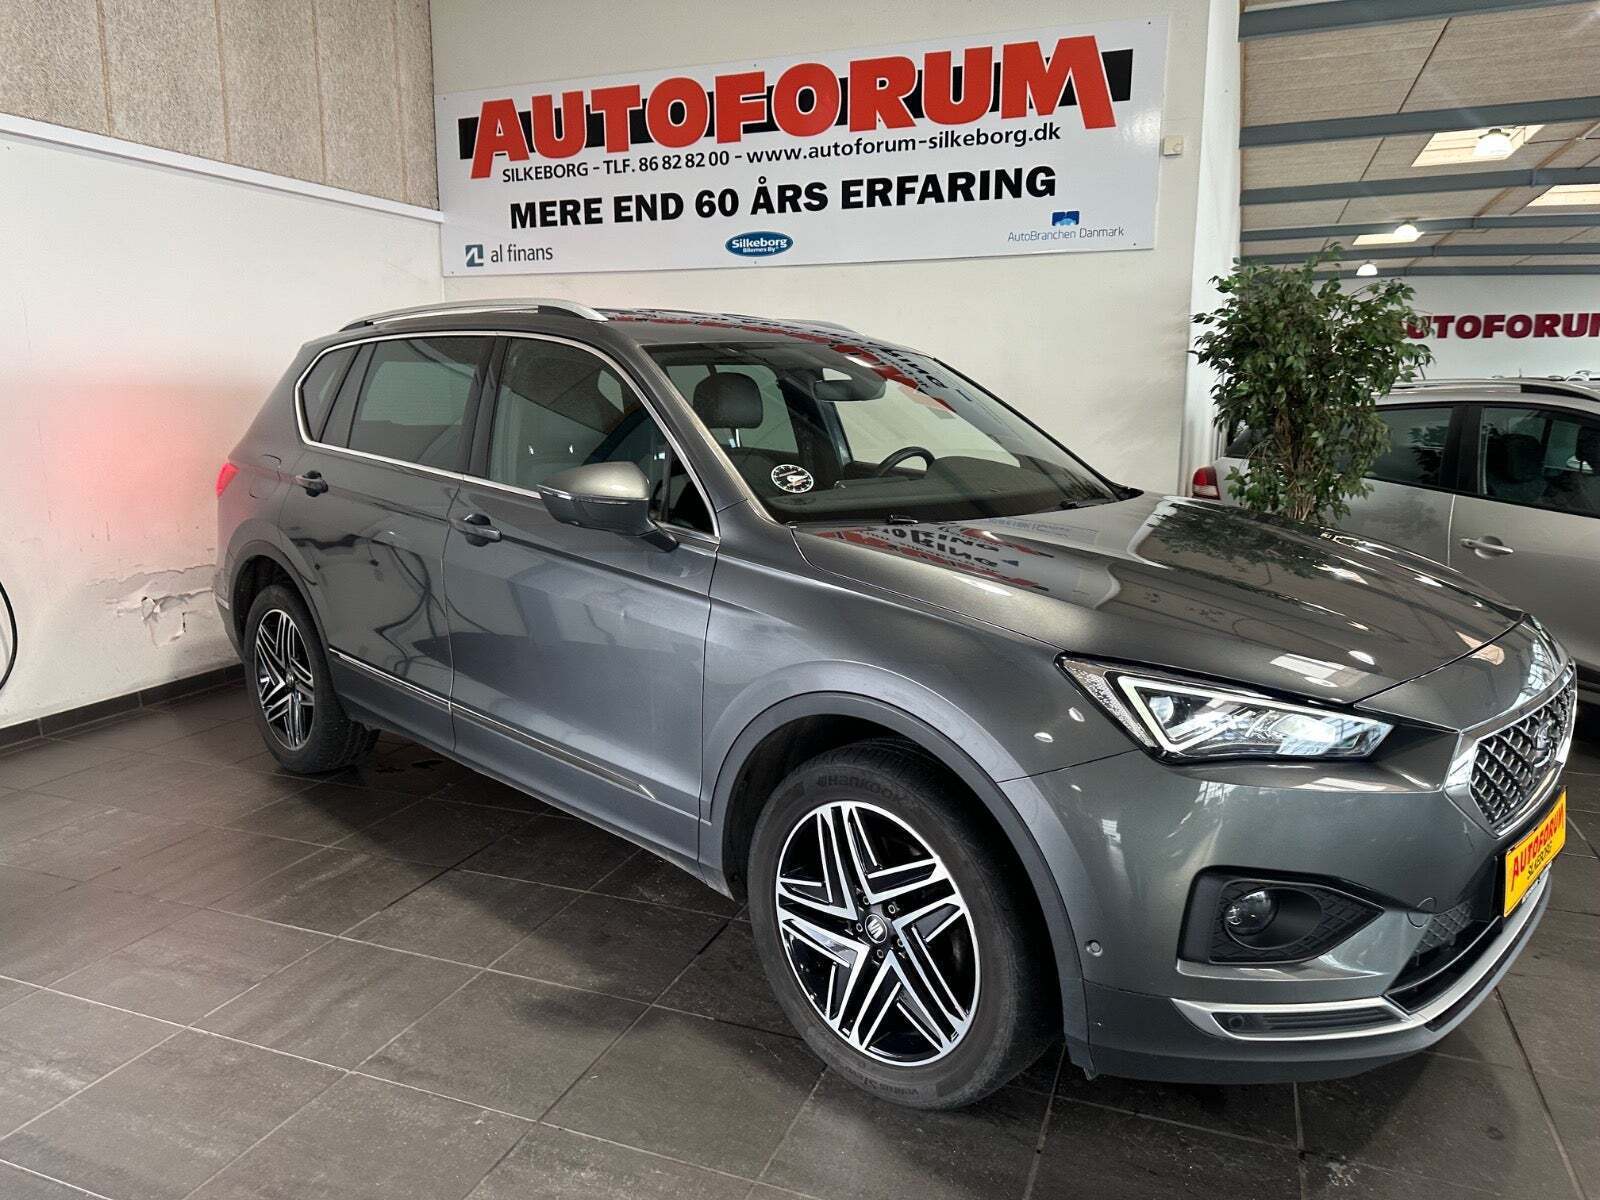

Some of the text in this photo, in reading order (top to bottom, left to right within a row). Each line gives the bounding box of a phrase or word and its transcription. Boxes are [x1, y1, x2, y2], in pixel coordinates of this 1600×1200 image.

[471, 36, 1116, 178] AUTOFORUM
[503, 162, 588, 182] SILKEBORG
[603, 158, 636, 175] TLF.
[639, 156, 659, 171] 86
[662, 155, 682, 170] 82
[685, 153, 706, 168] 82
[708, 151, 730, 166] 00
[747, 122, 1061, 163] www.autoforum-silkeborg.dk
[511, 166, 1056, 229] MERE END 60 ÅRS ERFARING
[732, 237, 788, 249] Silkeborg
[1007, 226, 1124, 242] AutoBranchen Danmark
[490, 244, 554, 263] al finans
[1407, 312, 1600, 339] UTOFORU
